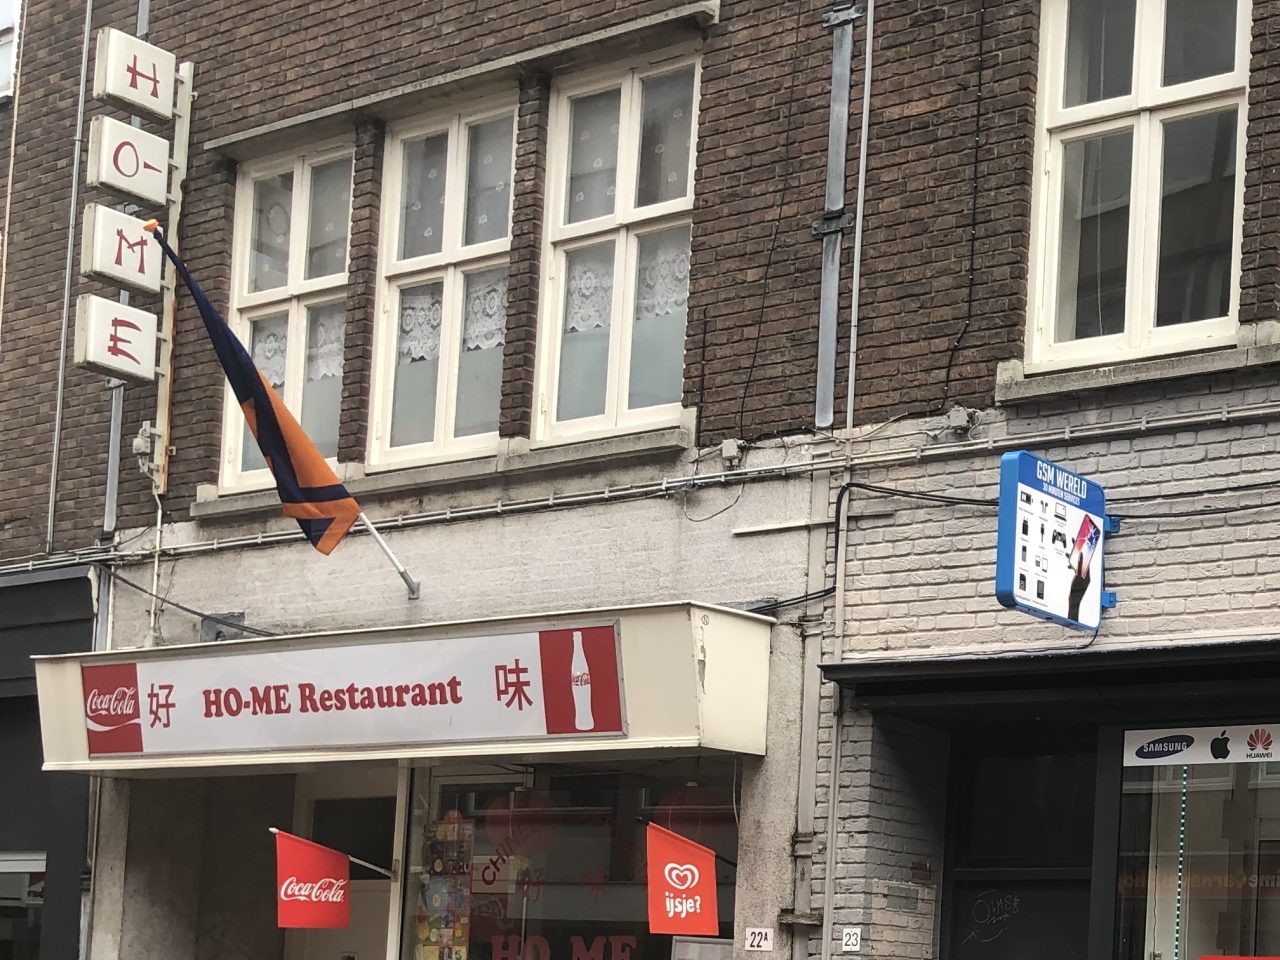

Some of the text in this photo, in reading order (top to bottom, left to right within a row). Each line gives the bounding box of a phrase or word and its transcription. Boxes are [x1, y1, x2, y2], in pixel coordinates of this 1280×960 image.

[1037, 460, 1088, 499] GSM WERELD
[203, 676, 463, 718] HO-ME Restaurant
[494, 658, 533, 711] 味
[147, 683, 176, 729] 好
[1143, 742, 1188, 752] SAMSUNG
[280, 876, 348, 903] Coca-Cola
[664, 891, 701, 918] ijsje?
[749, 931, 769, 948] 22A
[844, 932, 859, 947] 23
